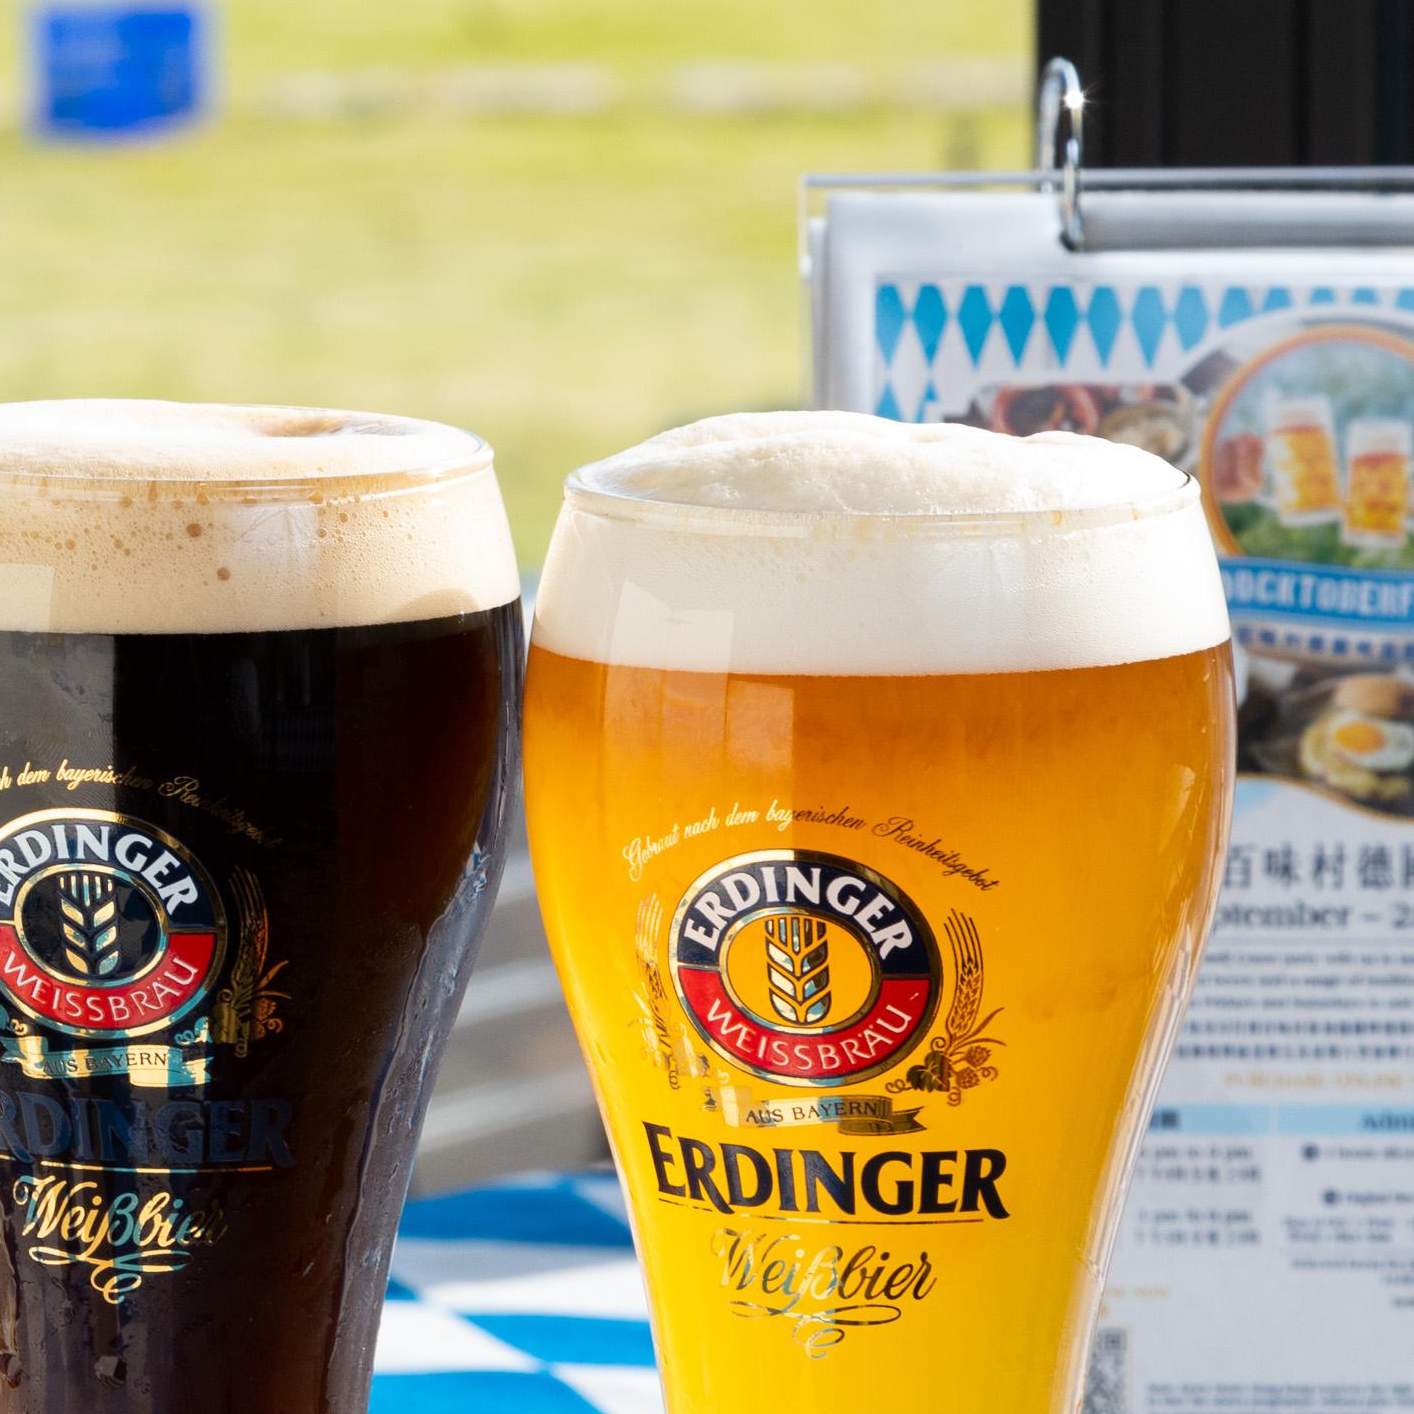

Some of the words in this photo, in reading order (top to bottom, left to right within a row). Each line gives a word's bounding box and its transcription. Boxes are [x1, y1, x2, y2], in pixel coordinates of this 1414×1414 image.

[17, 761, 51, 786] dem
[622, 823, 681, 883] Gebraut
[684, 806, 721, 839] nach
[725, 801, 761, 827] dem
[766, 799, 867, 832] bayerischen
[872, 816, 1000, 891] Reinheitsgebot
[683, 866, 913, 960] ERDINGER
[3, 950, 200, 1021] WEISSBRÄU
[42, 1058, 78, 1076] AUS
[86, 1051, 168, 1070] BAYERN
[707, 998, 913, 1070] WEISSBRÄU
[745, 1107, 784, 1124] AUS
[793, 1101, 878, 1121] BAYERN
[642, 1121, 1011, 1220] ERDINGER
[13, 1175, 229, 1260] Weißbier
[710, 1226, 937, 1314] Weißbier
